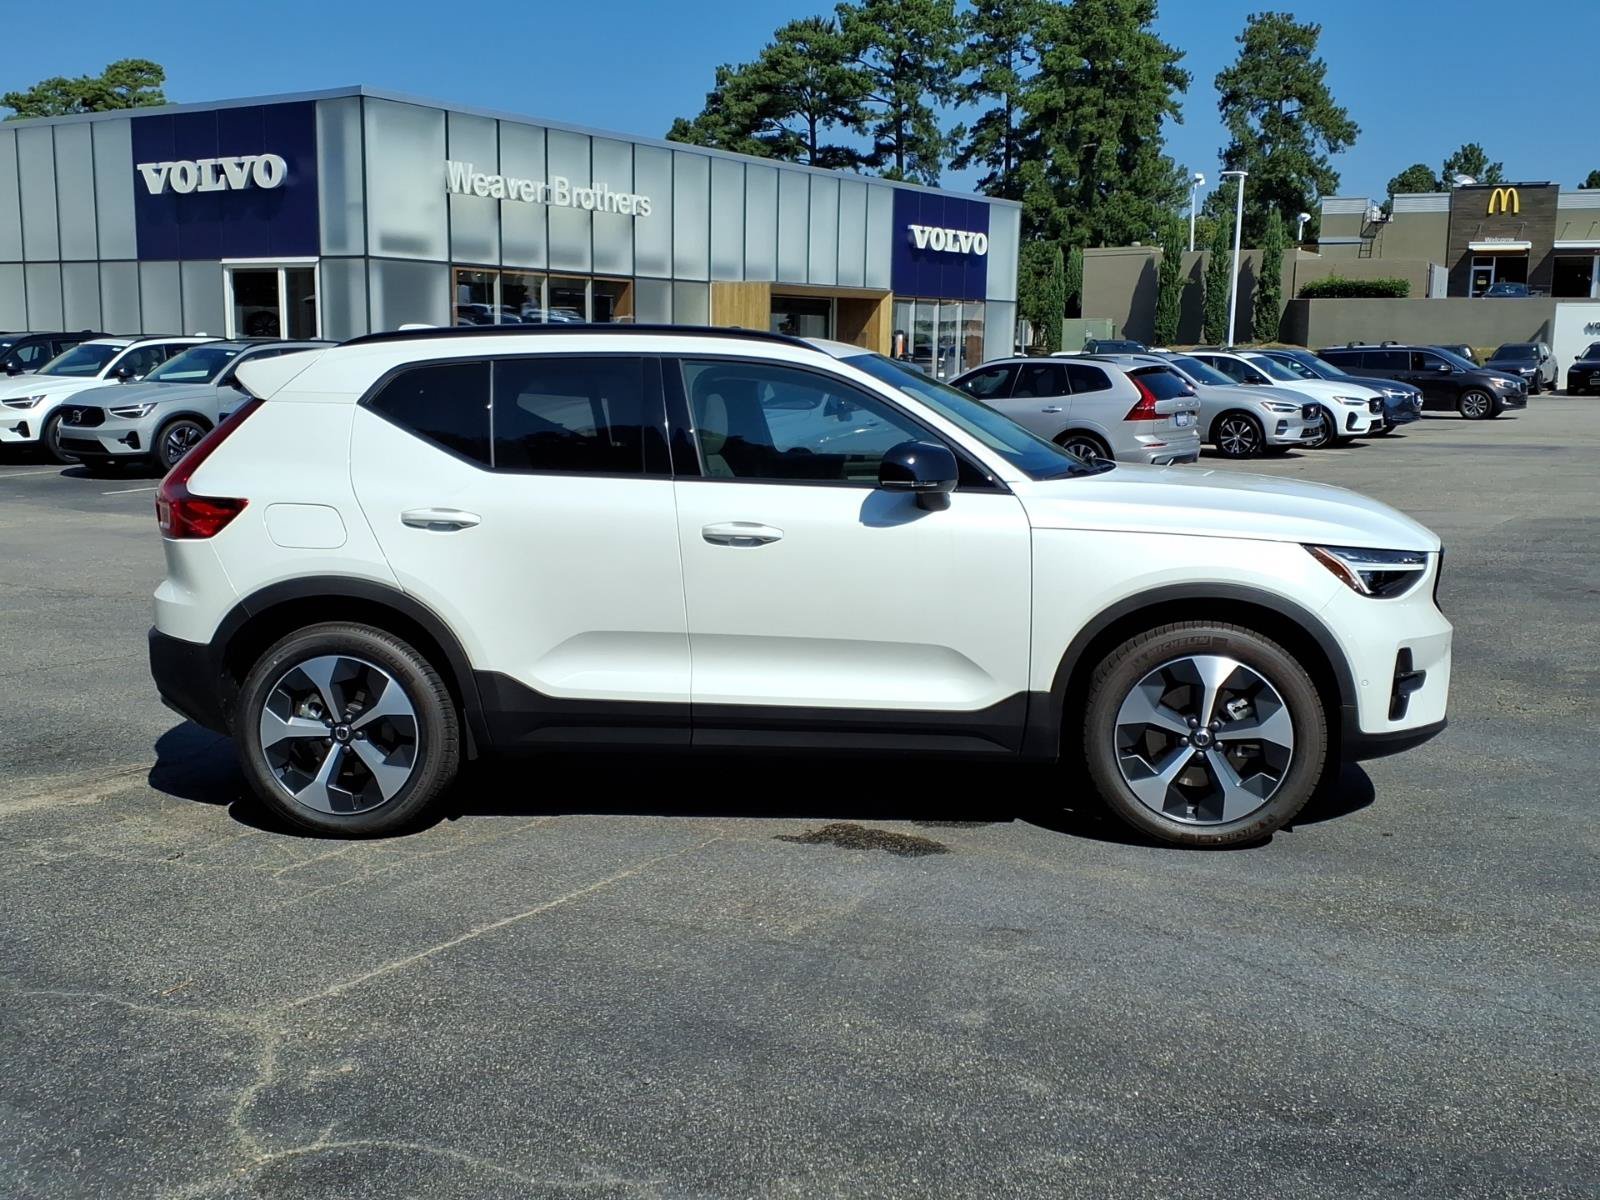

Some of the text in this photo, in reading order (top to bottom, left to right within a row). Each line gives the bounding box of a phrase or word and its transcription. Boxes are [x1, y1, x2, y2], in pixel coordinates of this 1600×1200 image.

[136, 153, 288, 195] VOLVO
[446, 160, 651, 217] Weaver Brothers
[908, 224, 988, 256] VOLVO
